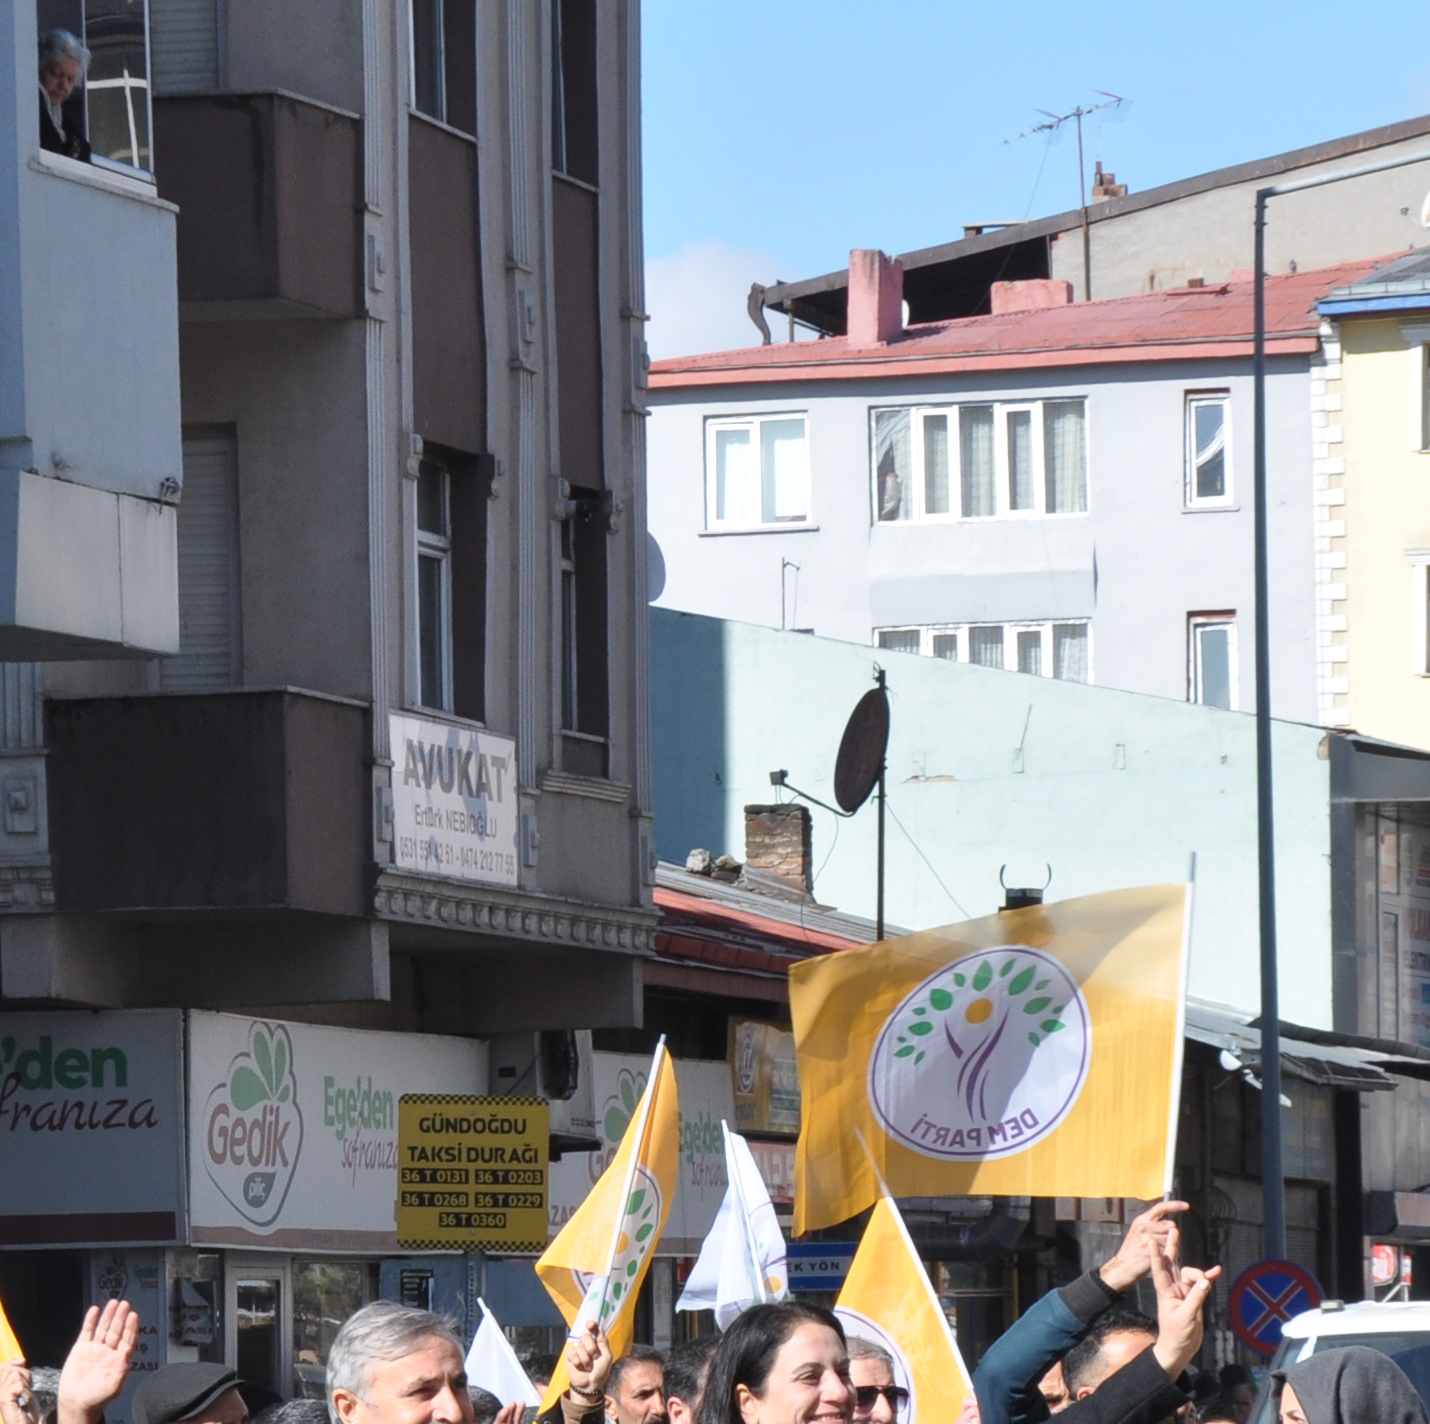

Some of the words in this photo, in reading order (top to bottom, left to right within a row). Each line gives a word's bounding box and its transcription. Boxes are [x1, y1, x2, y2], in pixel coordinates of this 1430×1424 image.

[403, 738, 506, 803] AVUKAT
[323, 1075, 394, 1141] Ege'den
[419, 1113, 527, 1135] GÜNDOĞDU
[207, 1103, 291, 1168] Gedik
[408, 1142, 462, 1163] TAKSİ
[466, 1143, 538, 1164] DURAĞI
[403, 1170, 419, 1182] 36
[425, 1170, 433, 1182] T
[436, 1170, 466, 1183] 0131
[476, 1171, 493, 1183] 36
[497, 1171, 505, 1183] T
[508, 1171, 541, 1183] 0203
[403, 1194, 419, 1205] 36
[423, 1194, 431, 1205] T
[434, 1194, 466, 1206] 0268
[476, 1195, 493, 1206] 36
[497, 1195, 505, 1206] T
[508, 1195, 541, 1207] 0229
[440, 1214, 456, 1226] 36
[460, 1214, 468, 1226] T
[471, 1214, 505, 1227] 0360
[787, 1261, 803, 1272] EK
[808, 1259, 840, 1273] YÖN
